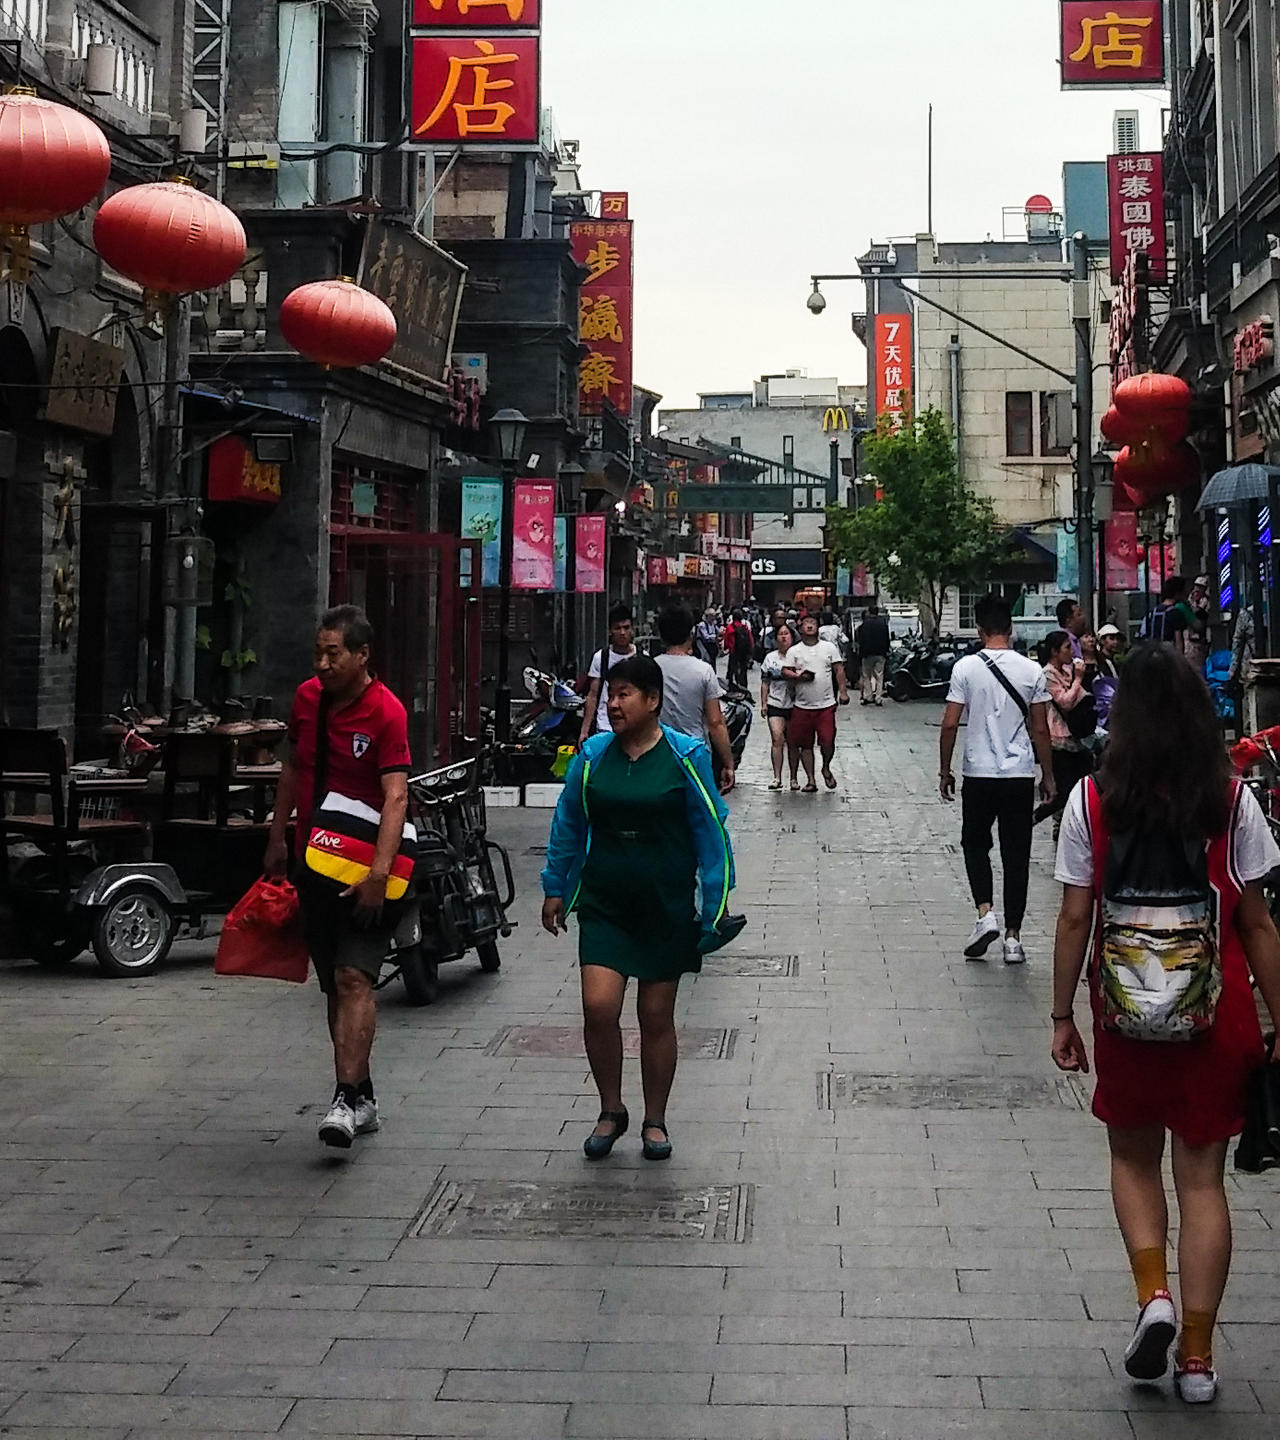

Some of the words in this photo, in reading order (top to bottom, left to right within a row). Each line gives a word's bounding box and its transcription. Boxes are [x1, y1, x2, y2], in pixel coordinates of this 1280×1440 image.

[1118, 175, 1155, 254] 泰國佛
[312, 829, 345, 849] live
